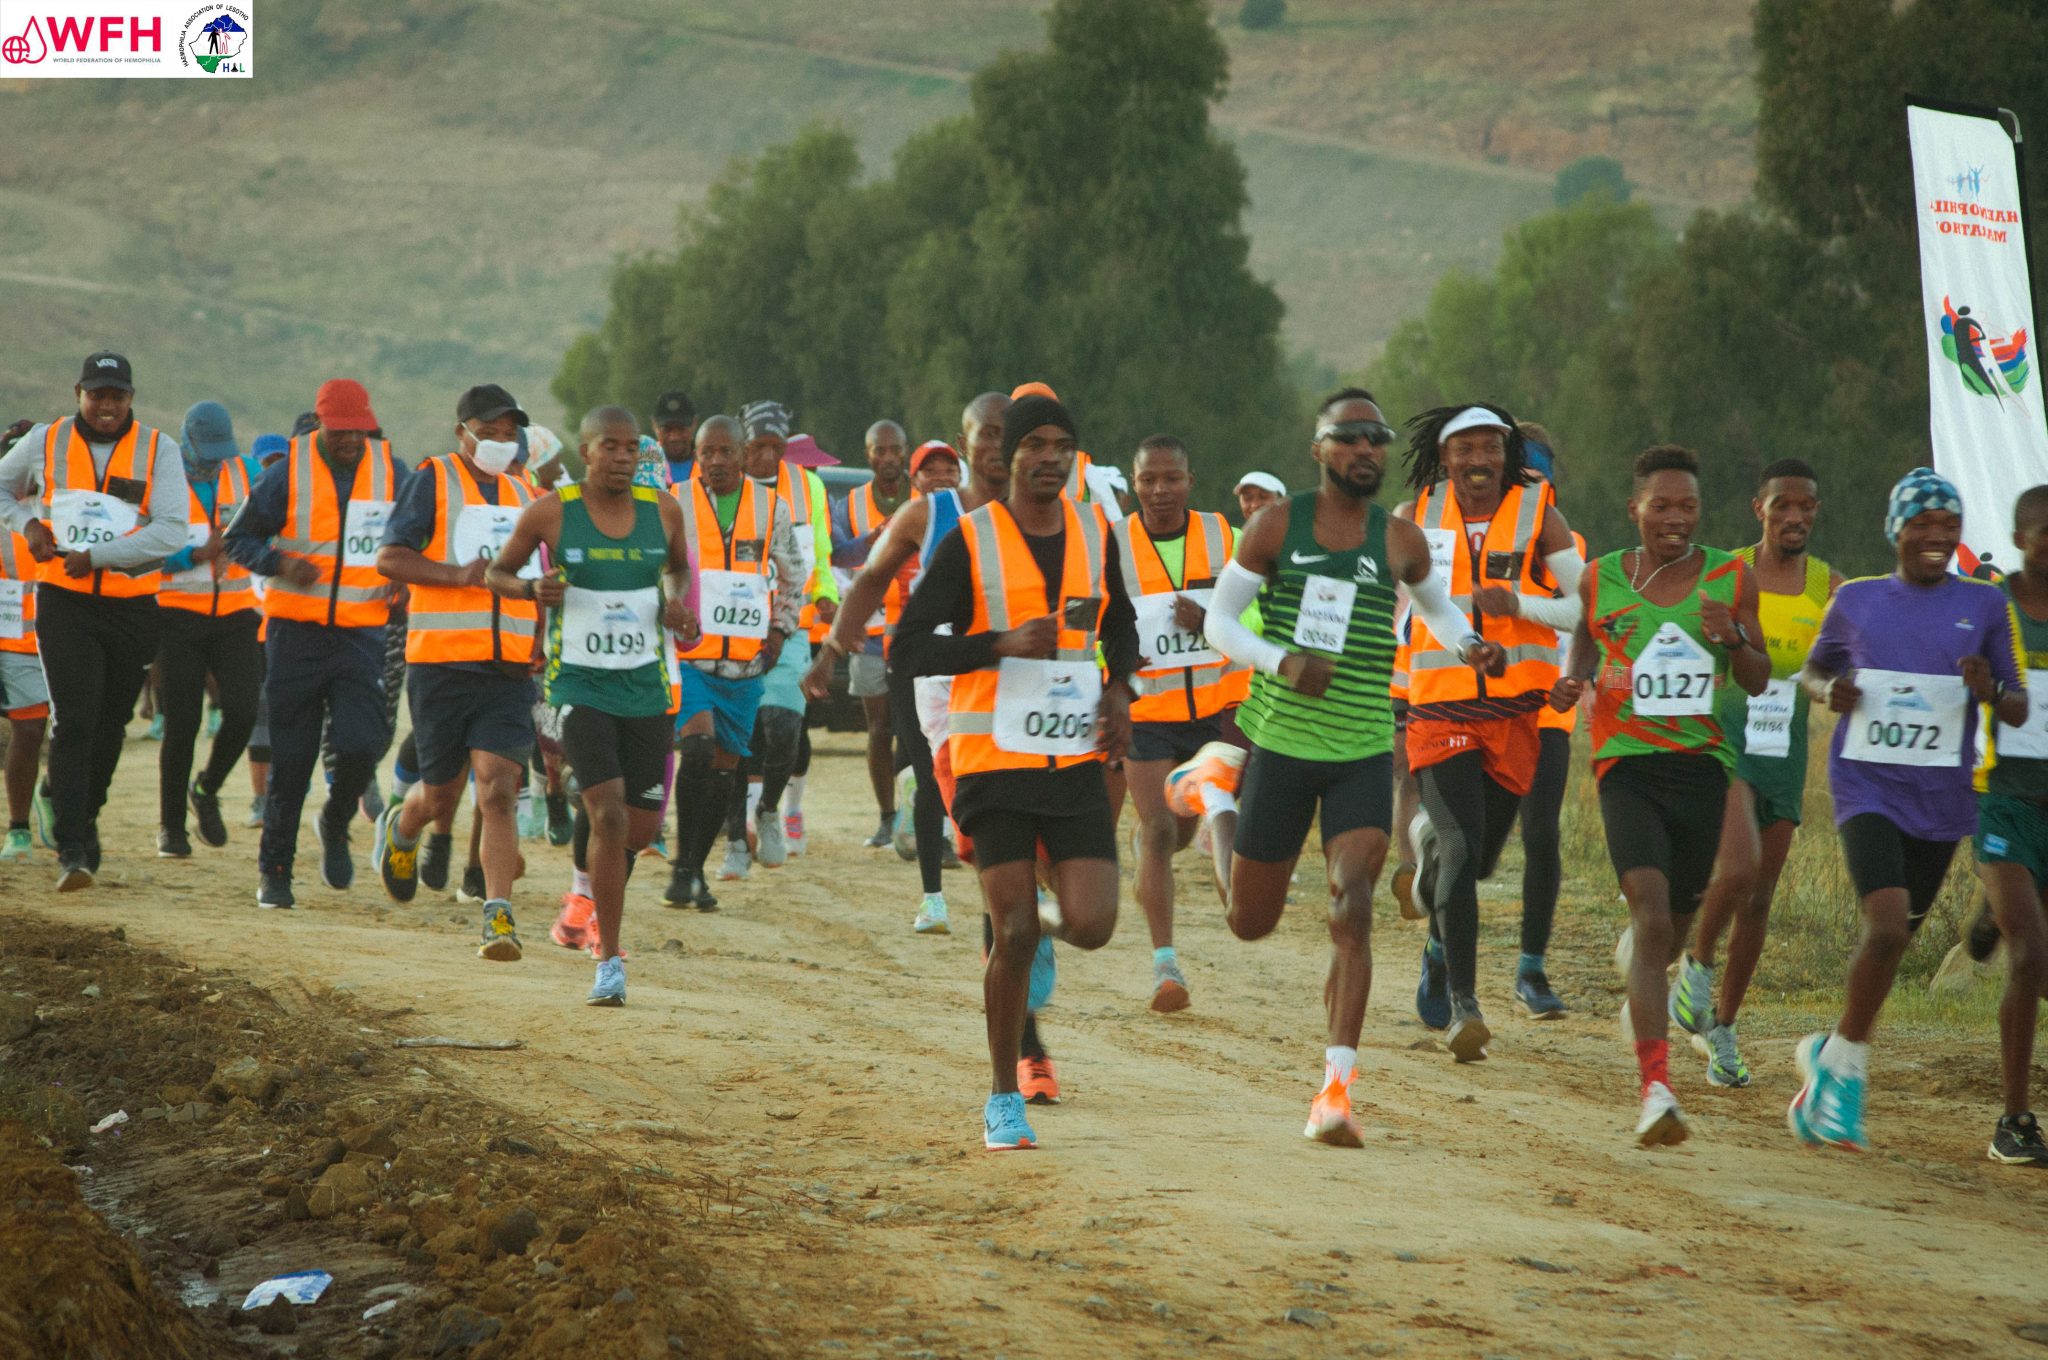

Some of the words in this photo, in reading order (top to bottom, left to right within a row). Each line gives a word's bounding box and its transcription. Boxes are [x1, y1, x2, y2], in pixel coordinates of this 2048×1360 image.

[96, 358, 118, 368] VANS
[713, 605, 762, 626] 0129
[586, 632, 645, 654] 0199
[1636, 673, 1712, 699] 0127
[1868, 720, 1940, 750] 0072
